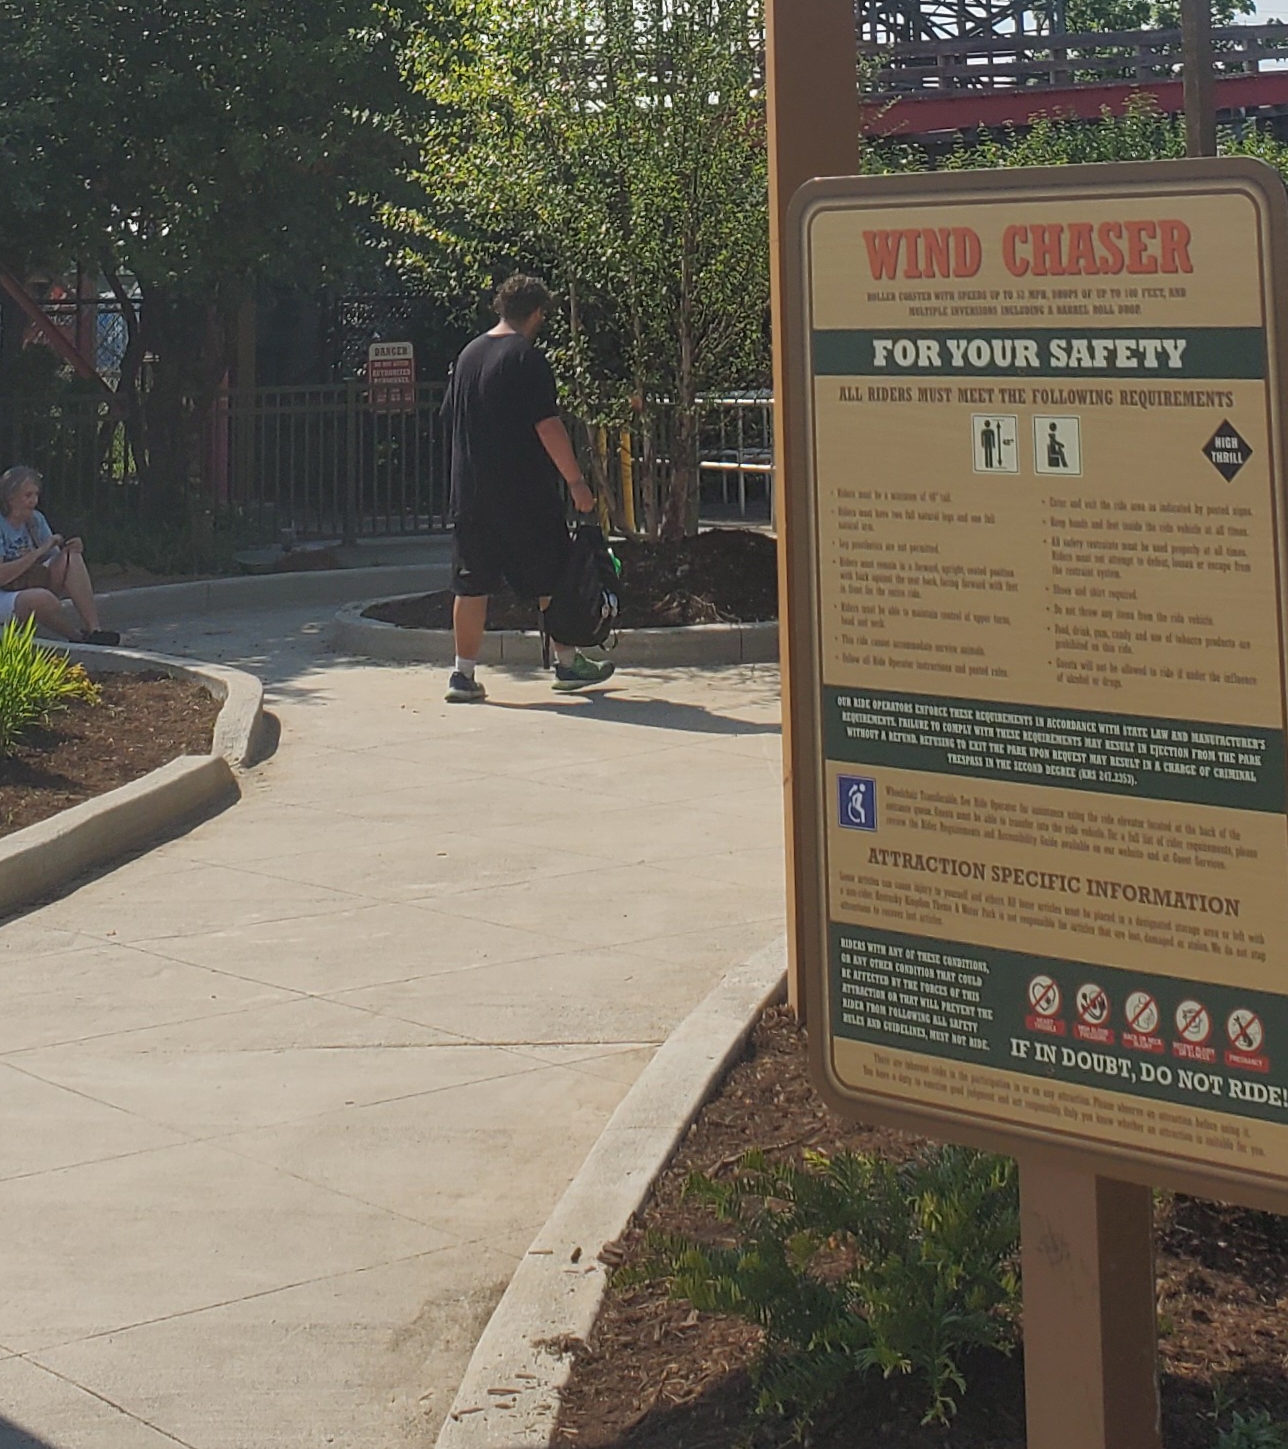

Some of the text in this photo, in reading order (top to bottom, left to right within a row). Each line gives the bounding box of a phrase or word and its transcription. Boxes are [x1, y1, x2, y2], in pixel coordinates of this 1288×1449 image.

[862, 219, 1194, 280] WIND CHASER
[374, 346, 408, 356] DANGER
[873, 339, 1186, 368] FOR YOUR SAFETY
[839, 386, 1234, 409] ALL RIDERS MUST MEET THE FOLLOWING REQUIREMENTS
[1211, 451, 1243, 464] THRILL
[1214, 437, 1239, 449] HIGH
[837, 696, 851, 706] OUR
[853, 698, 870, 708] RIDE
[872, 700, 912, 713] OPERATORS
[915, 704, 948, 717] ENFORCE
[950, 707, 973, 719] THESE
[976, 710, 1033, 728] REQUIREMENTS
[1036, 716, 1044, 727] IN
[1046, 717, 1096, 732] ACCORDANCE
[1098, 723, 1120, 735] WITH
[1122, 725, 1148, 738] STATE
[1150, 728, 1168, 740] LAW
[1172, 730, 1188, 742] AND
[846, 726, 879, 739] WITHOUT
[881, 730, 886, 740] A
[920, 735, 954, 748] REFUSING
[956, 739, 966, 749] TO
[969, 740, 986, 751] EXIT
[989, 742, 1004, 753] THE
[1007, 744, 1026, 756] PARK
[1030, 747, 1050, 759] UPON
[1052, 749, 1087, 765] REQUEST
[1090, 753, 1106, 765] MAY
[1110, 755, 1140, 769] RESULT
[1143, 759, 1152, 770] IN
[1154, 760, 1160, 771] A
[1164, 761, 1196, 775] CHARGE
[1200, 765, 1210, 777] OF
[1214, 767, 1256, 782] CRIMINAL
[931, 721, 940, 731] TO
[943, 722, 972, 734] COMPLY
[974, 725, 994, 737] WITH
[996, 728, 1020, 740] THESE
[1023, 731, 1082, 749] REQUIREMENTS
[1085, 737, 1102, 749] MAY
[1106, 739, 1134, 752] RESULT
[1138, 743, 1146, 754] IN
[1150, 744, 1188, 758] EJECTION
[1192, 749, 1215, 761] FROM
[1218, 751, 1235, 763] THE
[1238, 754, 1261, 766] PARK
[947, 753, 982, 767] TRESPASS
[986, 758, 994, 768] IN
[996, 759, 1012, 770] THE
[1014, 761, 1042, 774] SECOND
[1046, 764, 1076, 778] DEGREE
[868, 847, 986, 881] ATTRACTION
[991, 865, 1081, 893] SPECIFIC
[1086, 878, 1240, 917] INFORMATION
[840, 938, 866, 951] RIDERS
[866, 943, 886, 955] WITH
[888, 945, 903, 958] ANY
[906, 949, 915, 959] OF
[916, 951, 940, 965] THESE
[841, 953, 982, 987] OR ANY OTHER CONDITION THAT COULD
[842, 968, 980, 1001] BE AFFECTED BY THE FORCES OF THIS
[842, 983, 993, 1020] ATTRACTION OR THAT WILL PREVENT THE
[842, 998, 978, 1033] RIDER FROM FOLLOWING ALL SAFETY
[843, 1013, 864, 1025] RULES
[866, 1017, 881, 1029] AND
[930, 1029, 950, 1042] MUST
[952, 1033, 967, 1046] NOT
[1010, 1038, 1288, 1108] IF IN DOUBT, DO NOT RIDE!
